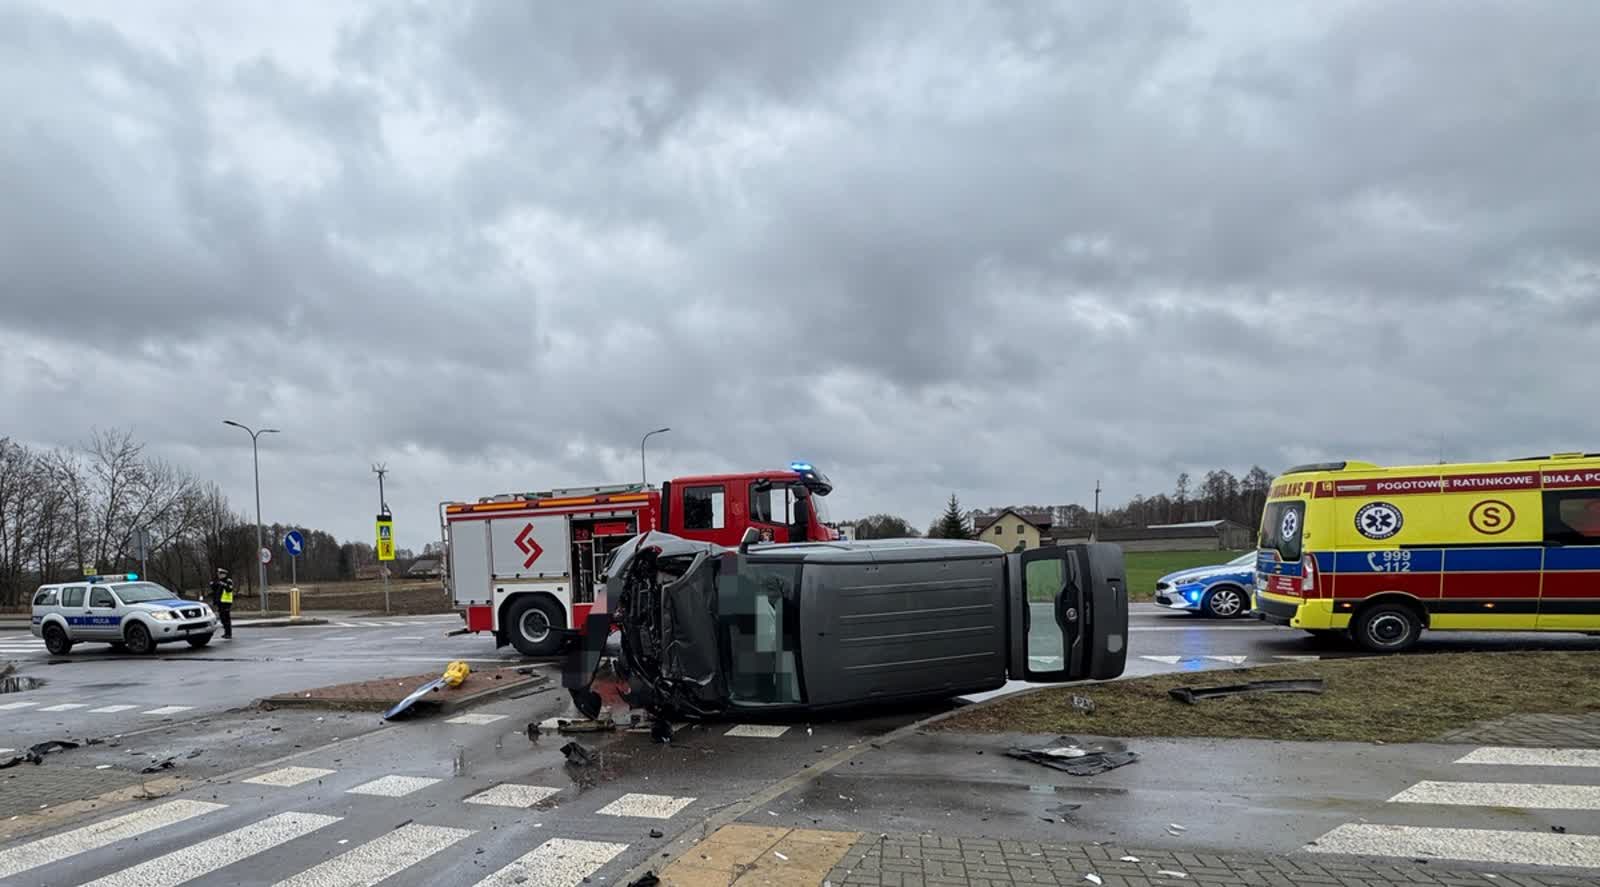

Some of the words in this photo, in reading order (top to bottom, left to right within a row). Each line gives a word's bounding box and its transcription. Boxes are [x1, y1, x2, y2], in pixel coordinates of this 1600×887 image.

[1376, 480, 1450, 490] POGOTOWIE
[1453, 475, 1533, 487] RATUNKOWE
[1543, 473, 1583, 484] BIAŁA
[1482, 506, 1502, 528] S
[1383, 551, 1411, 561] 999
[1383, 561, 1411, 572] 112
